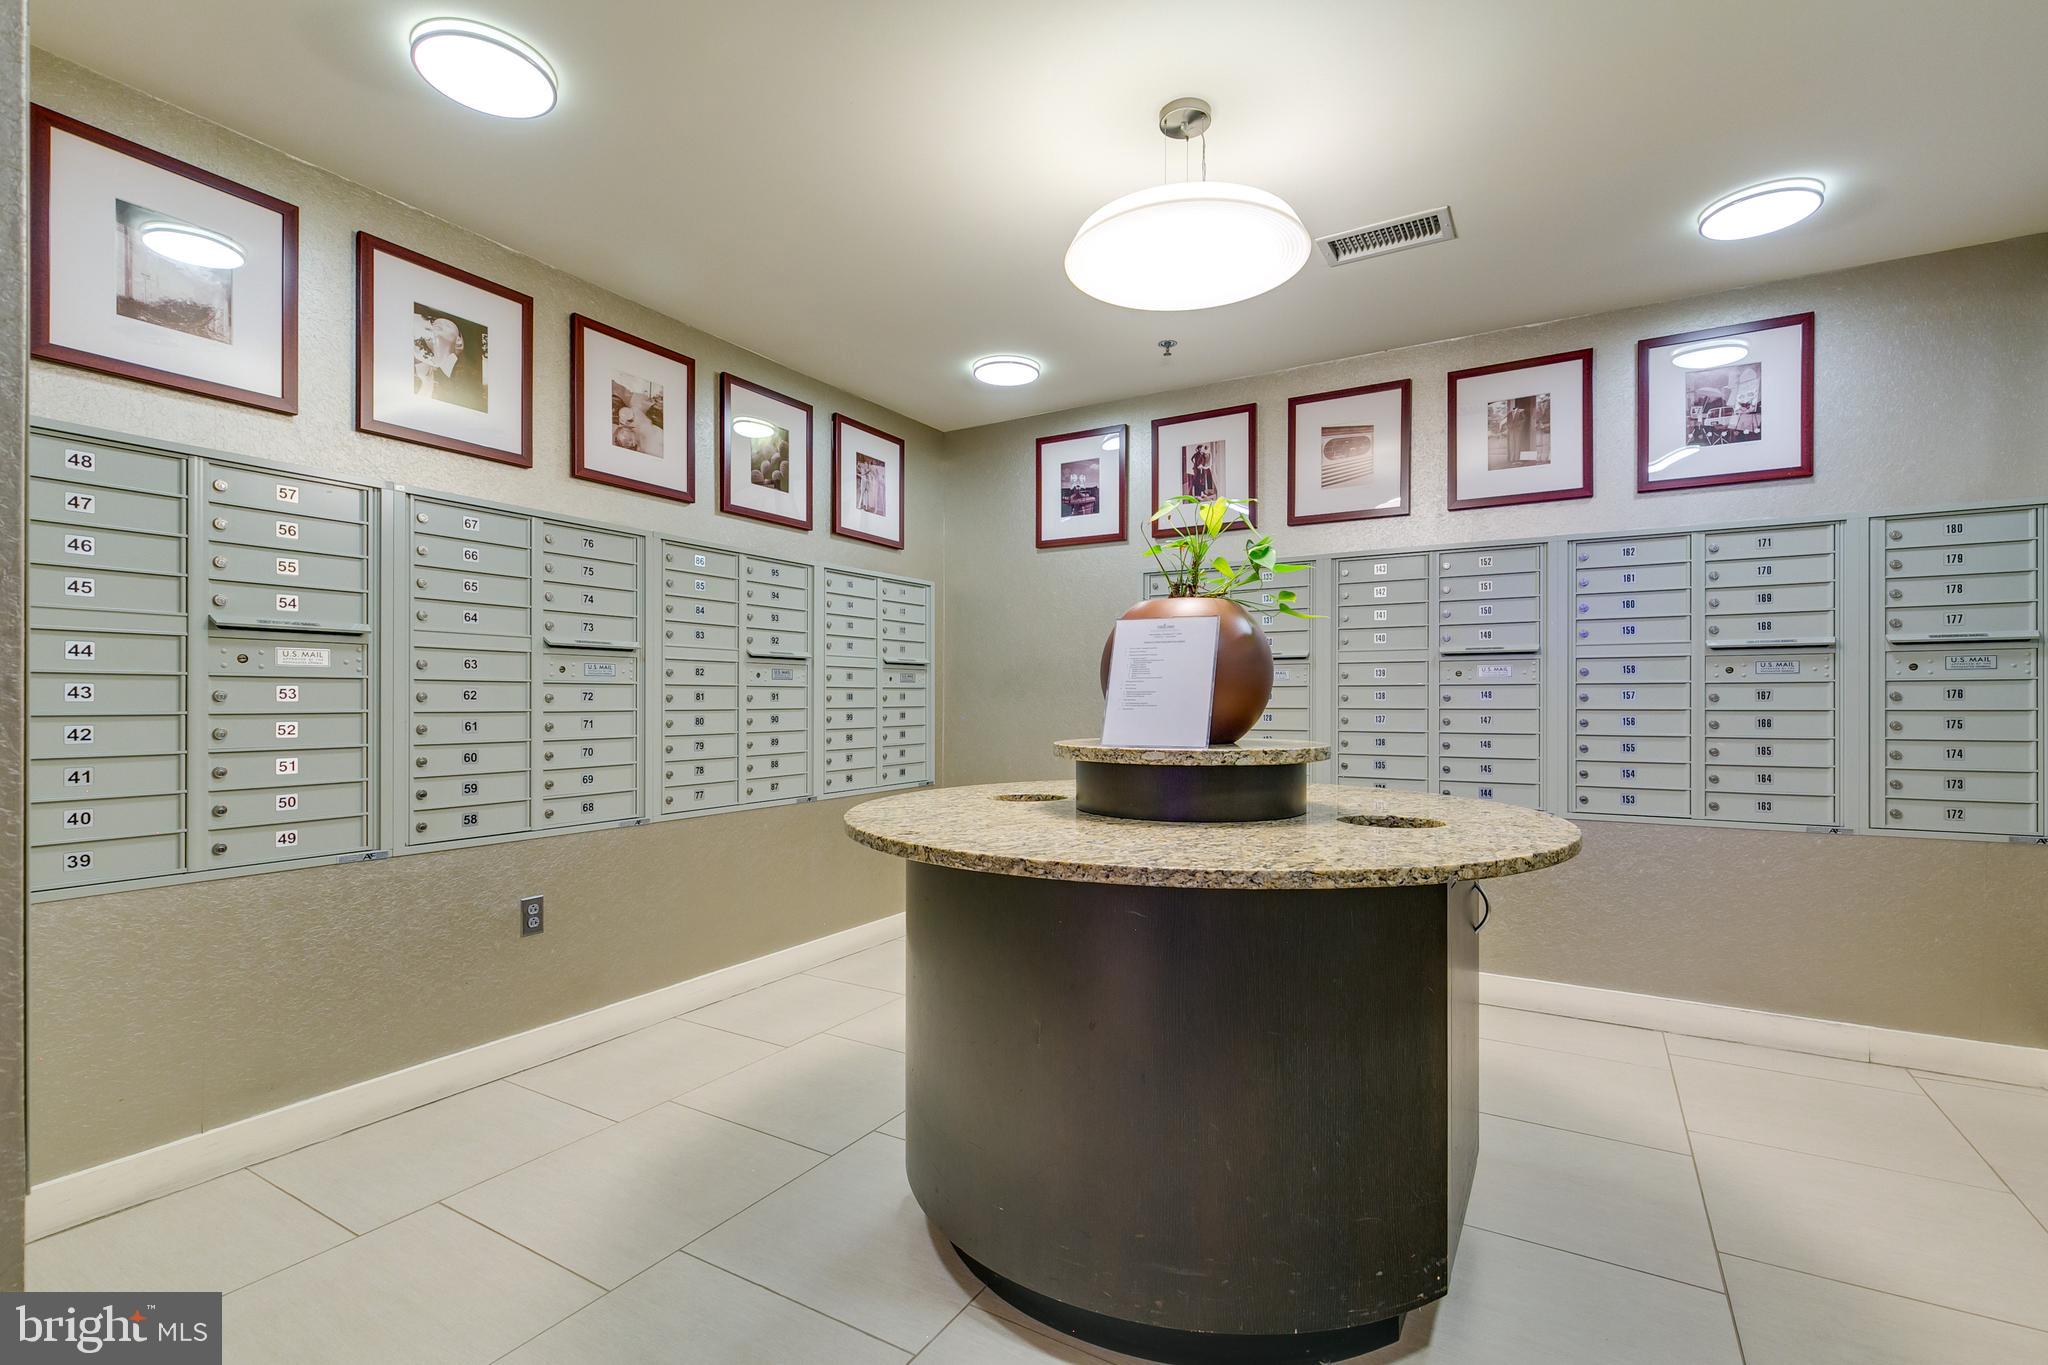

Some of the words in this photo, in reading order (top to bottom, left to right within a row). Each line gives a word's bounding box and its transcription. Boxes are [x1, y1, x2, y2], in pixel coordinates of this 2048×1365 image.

[67, 453, 93, 469] 48
[278, 487, 297, 500] 57
[67, 495, 93, 510] 47
[464, 518, 478, 530] 67
[1946, 523, 1963, 534] 180
[278, 524, 297, 537] 56
[67, 538, 92, 553] 46
[583, 538, 594, 549] 76
[1758, 537, 1772, 548] 171
[464, 549, 478, 561] 66
[1622, 547, 1636, 557] 162
[695, 557, 705, 566] 86
[1480, 557, 1492, 566] 152
[1946, 553, 1963, 564] 179
[278, 560, 297, 573] 55
[582, 566, 595, 577] 75
[1757, 565, 1772, 576] 170
[770, 568, 780, 577] 95
[1623, 573, 1635, 583] 161
[67, 580, 93, 594] 45
[464, 581, 478, 592] 65
[695, 582, 705, 591] 85
[1480, 582, 1492, 591] 151
[1946, 583, 1963, 594] 178
[583, 594, 594, 604] 74
[771, 591, 780, 600] 94
[1757, 592, 1772, 603] 169
[278, 596, 297, 609] 54
[1622, 599, 1635, 609] 160
[695, 606, 705, 615] 84
[1480, 606, 1492, 615] 150
[464, 612, 478, 623] 64
[770, 613, 779, 622] 93
[1946, 613, 1963, 625] 177
[582, 622, 594, 632] 73
[1622, 625, 1636, 635] 159
[1757, 621, 1772, 631] 168
[695, 630, 705, 640] 83
[770, 636, 780, 645] 92
[67, 643, 93, 658] 44
[282, 650, 299, 658] U.S.
[301, 650, 323, 658] MAIL
[463, 659, 478, 670] 63
[1622, 664, 1636, 674] 158
[695, 667, 705, 677] 82
[67, 686, 92, 699] 43
[278, 687, 298, 700] 53
[463, 690, 477, 701] 62
[582, 691, 594, 701] 72
[695, 692, 705, 701] 81
[770, 692, 779, 701] 91
[1622, 690, 1636, 700] 157
[1756, 690, 1771, 701] 167
[1946, 688, 1964, 699] 176
[583, 719, 593, 729] 71
[694, 717, 705, 726] 80
[770, 715, 780, 724] 90
[1480, 715, 1492, 724] 147
[1622, 717, 1636, 726] 156
[1757, 718, 1772, 728] 166
[1946, 719, 1963, 730] 175
[277, 723, 297, 736] 52
[464, 721, 478, 732] 61
[66, 728, 92, 742] 42
[695, 741, 705, 751] 79
[770, 737, 779, 746] 89
[582, 747, 594, 757] 70
[1622, 743, 1636, 753] 155
[1757, 746, 1772, 756] 165
[1946, 748, 1963, 759] 174
[463, 752, 478, 763] 60
[278, 759, 298, 772] 51
[770, 759, 779, 769] 88
[1480, 764, 1492, 774] 145
[695, 766, 705, 775] 78
[1622, 769, 1636, 779] 154
[67, 770, 90, 784] 41
[582, 774, 594, 785] 69
[1757, 773, 1772, 784] 164
[463, 783, 478, 794] 59
[770, 782, 779, 791] 87
[1946, 779, 1964, 790] 173
[694, 790, 705, 800] 77
[1480, 788, 1492, 798] 144
[278, 796, 297, 809] 50
[1622, 794, 1635, 805] 153
[582, 802, 594, 813] 68
[1757, 801, 1772, 811] 163
[66, 811, 91, 826] 40
[463, 814, 478, 825] 58
[1946, 808, 1964, 820] 172
[277, 832, 297, 845] 49
[67, 854, 91, 869] 39
